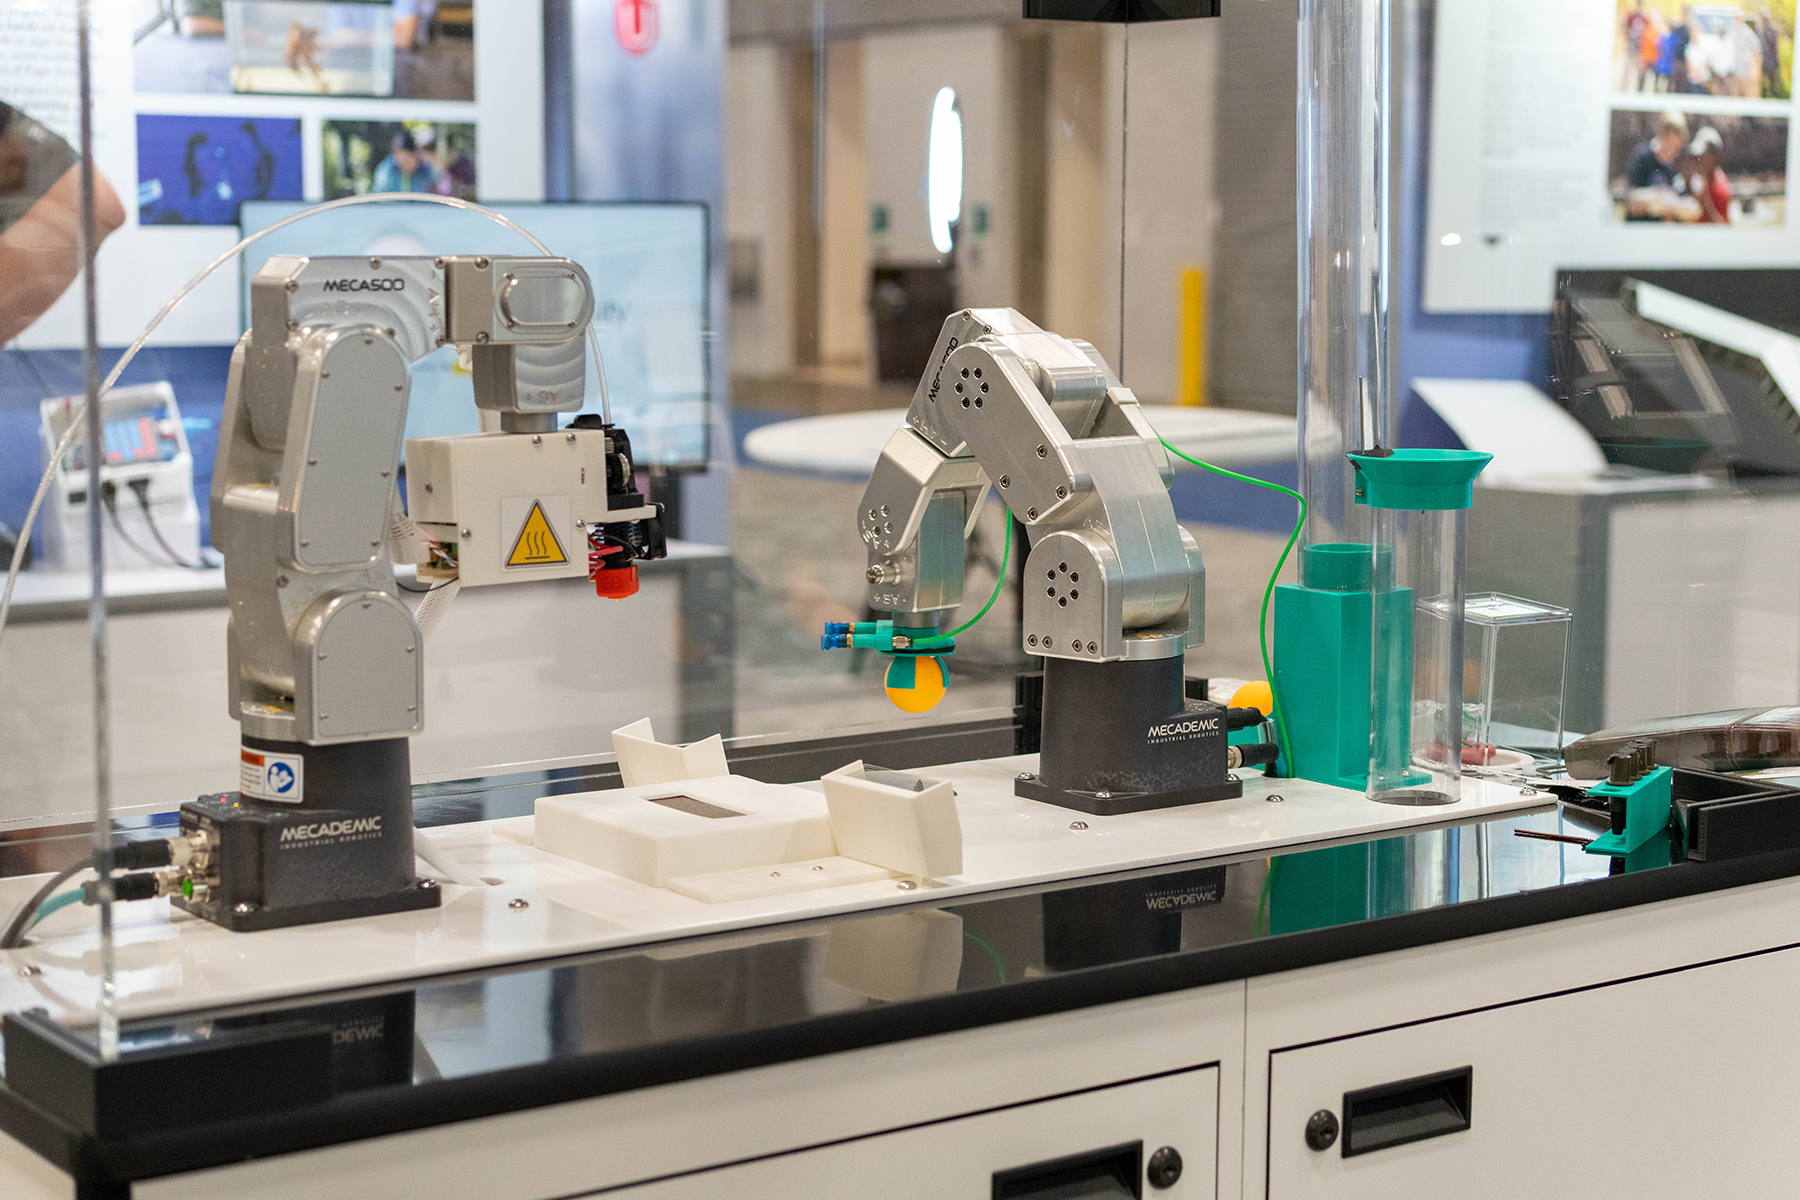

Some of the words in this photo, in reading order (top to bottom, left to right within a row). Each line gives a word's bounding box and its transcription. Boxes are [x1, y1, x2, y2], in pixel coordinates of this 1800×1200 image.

[323, 278, 405, 292] MECA500
[1147, 718, 1219, 738] MECADEMIC
[1147, 735, 1186, 745] INDUSTRIAL
[1189, 730, 1220, 740] ROBOTICS
[280, 815, 382, 842] MECADEMIC
